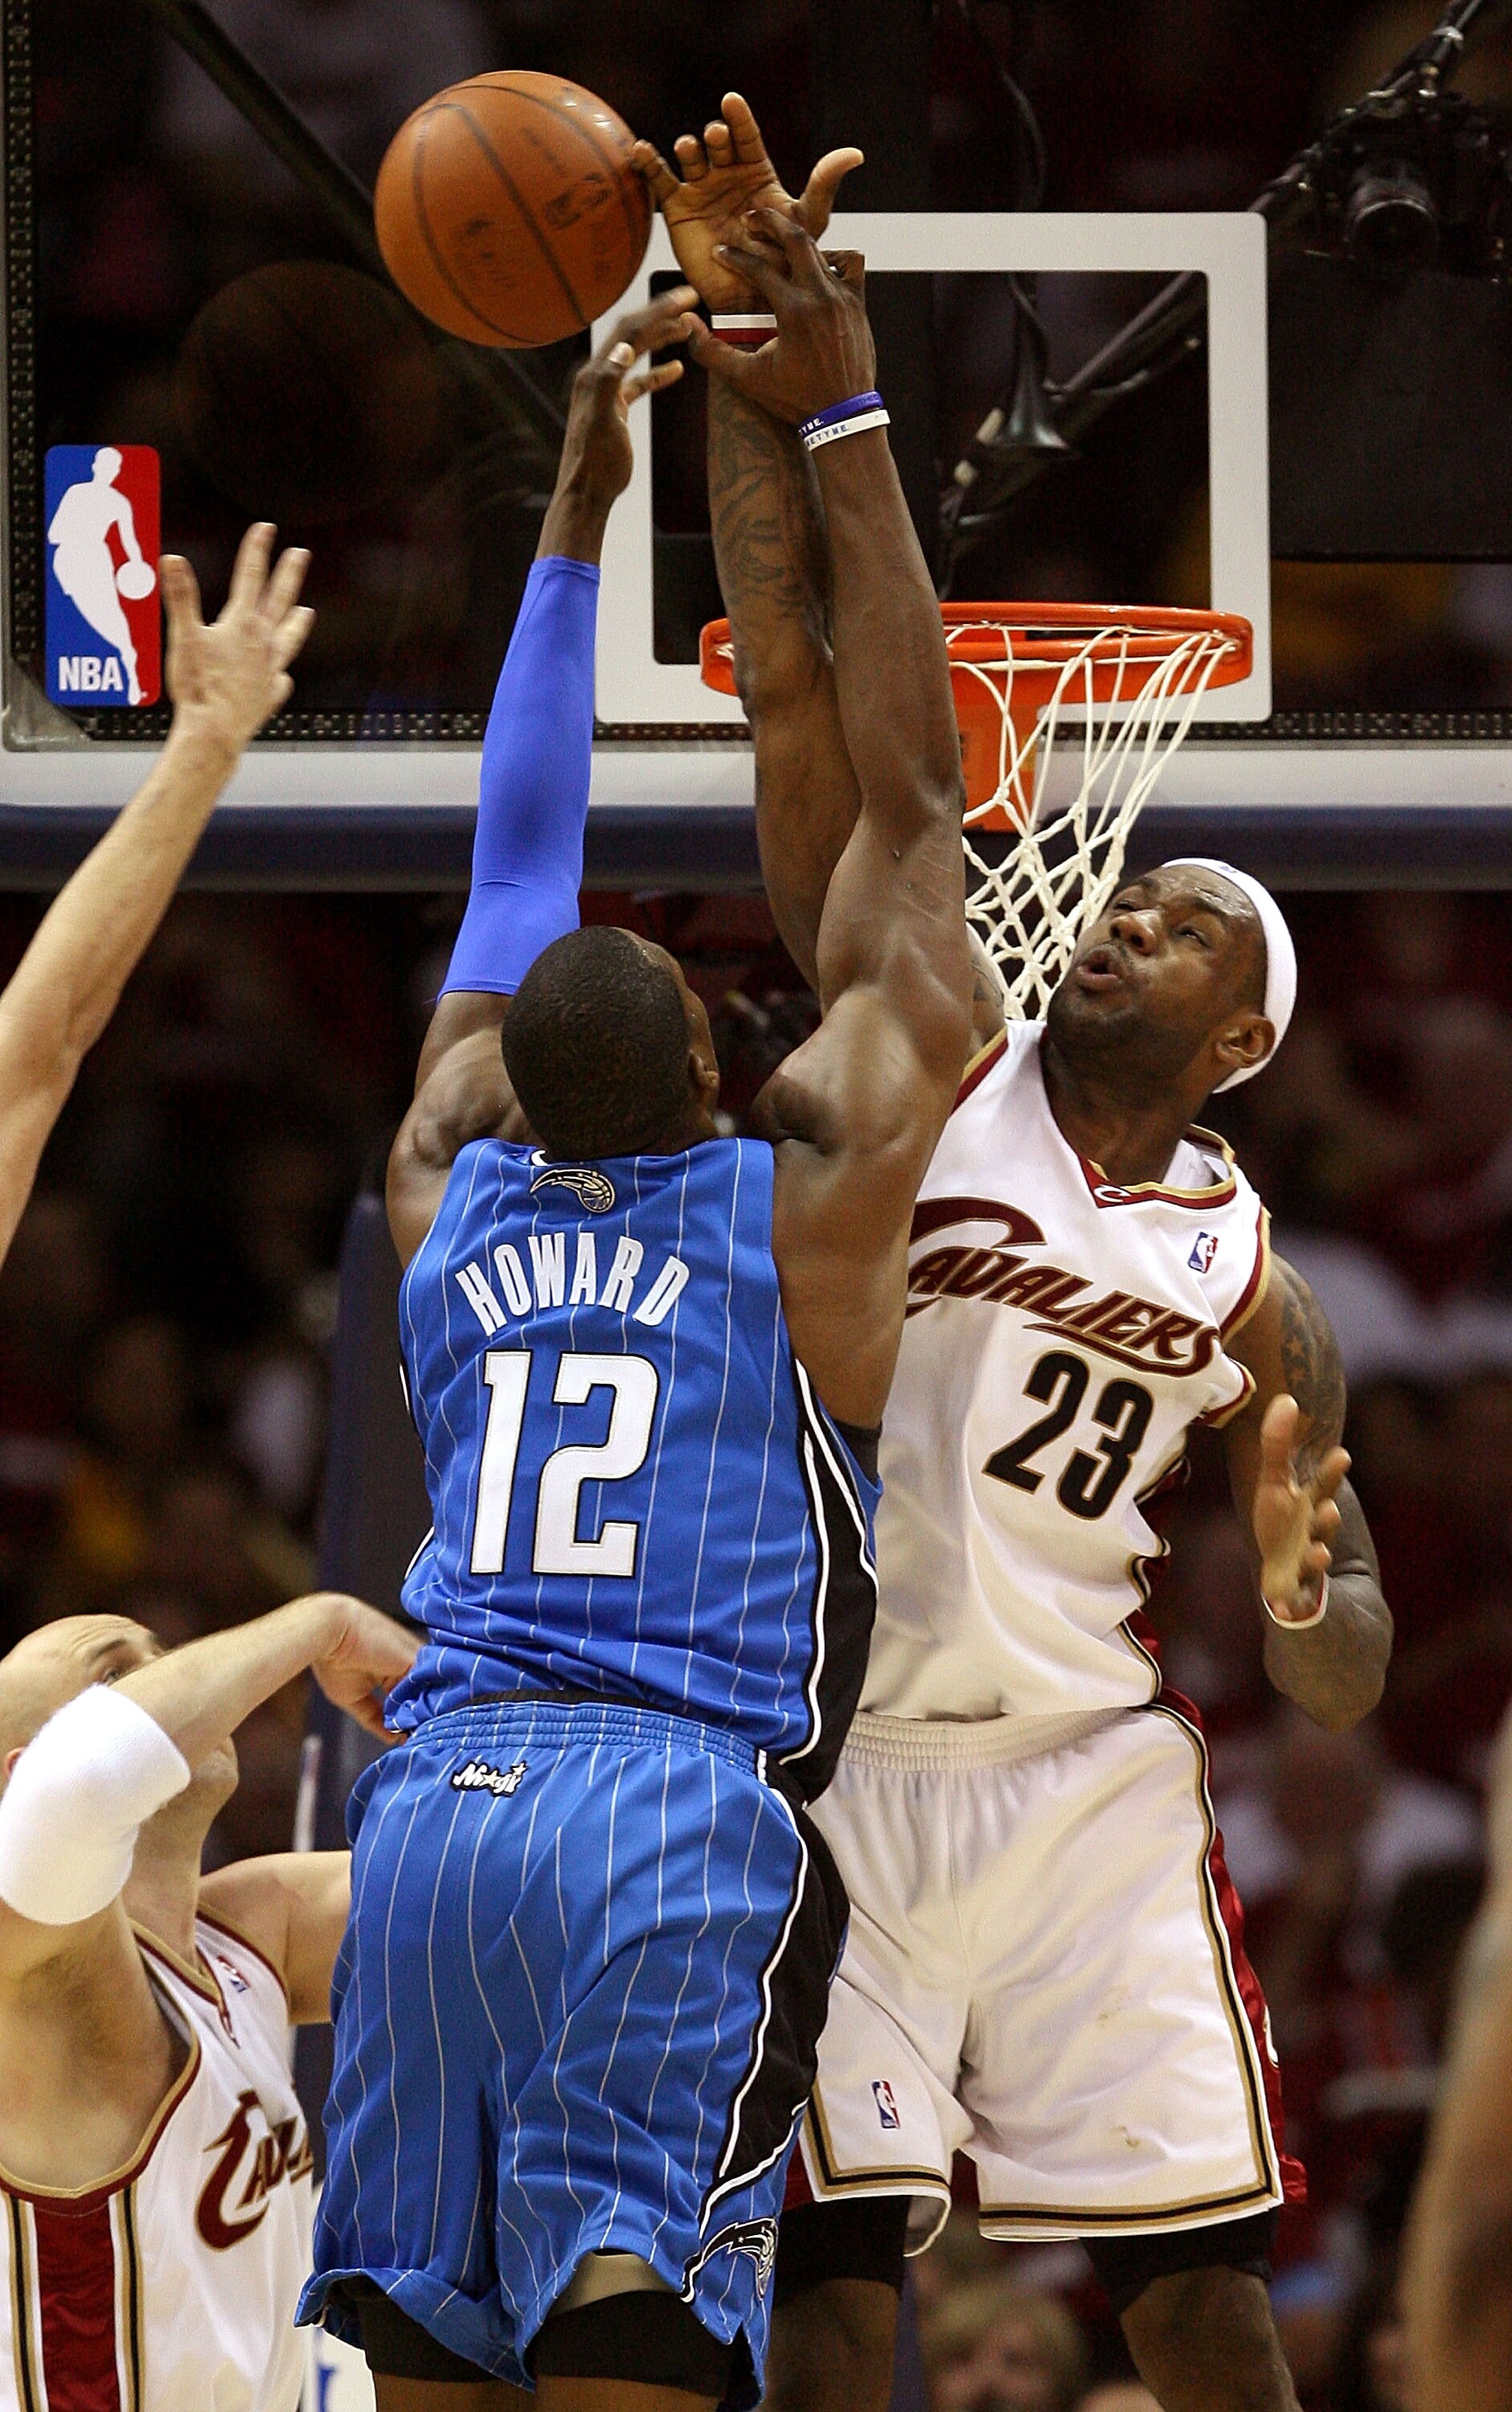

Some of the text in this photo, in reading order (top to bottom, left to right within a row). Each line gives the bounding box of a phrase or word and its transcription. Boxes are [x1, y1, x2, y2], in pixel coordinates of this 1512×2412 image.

[59, 655, 124, 691] NBA
[454, 1232, 690, 1337] HOWARD
[469, 1348, 658, 1577] 12
[981, 1349, 1155, 1521] 23
